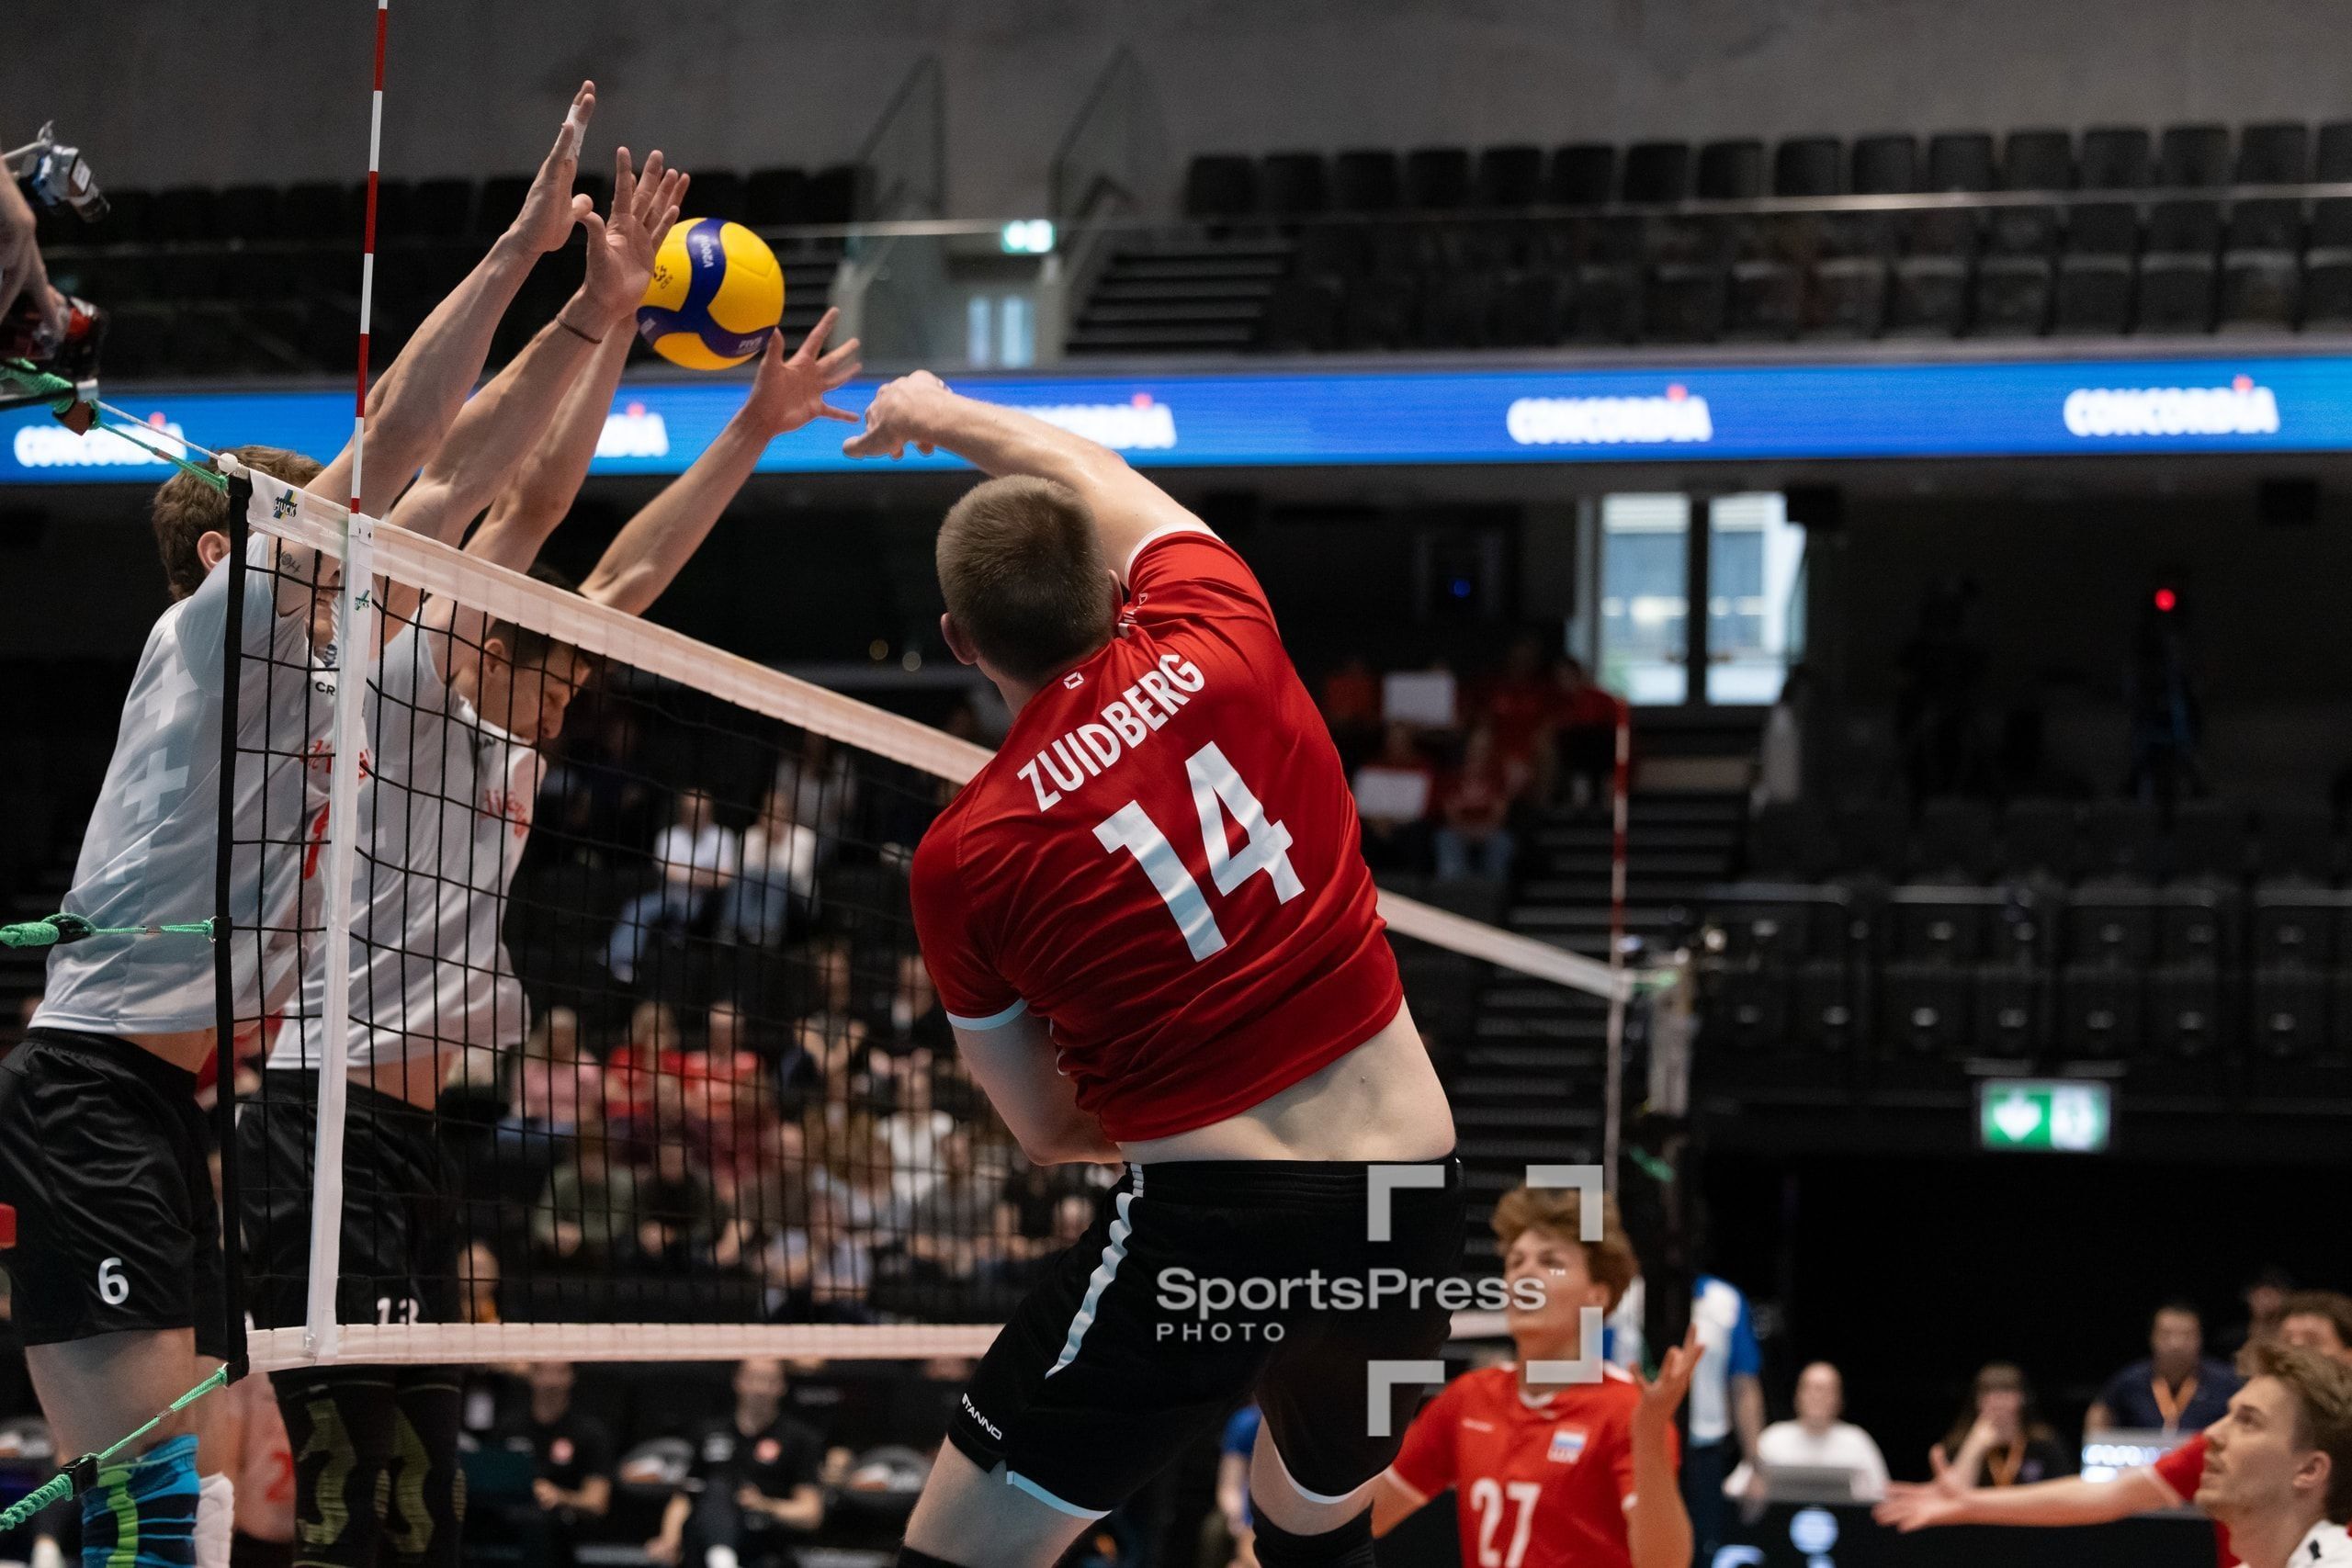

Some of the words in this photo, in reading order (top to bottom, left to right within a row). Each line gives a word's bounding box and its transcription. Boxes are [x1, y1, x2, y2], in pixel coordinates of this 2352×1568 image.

[274, 498, 298, 518] HUCK
[1017, 654, 1204, 813] ZUIDBERG
[1091, 740, 1306, 963] 14
[97, 1257, 130, 1305] 6
[1470, 1476, 1543, 1568] 27
